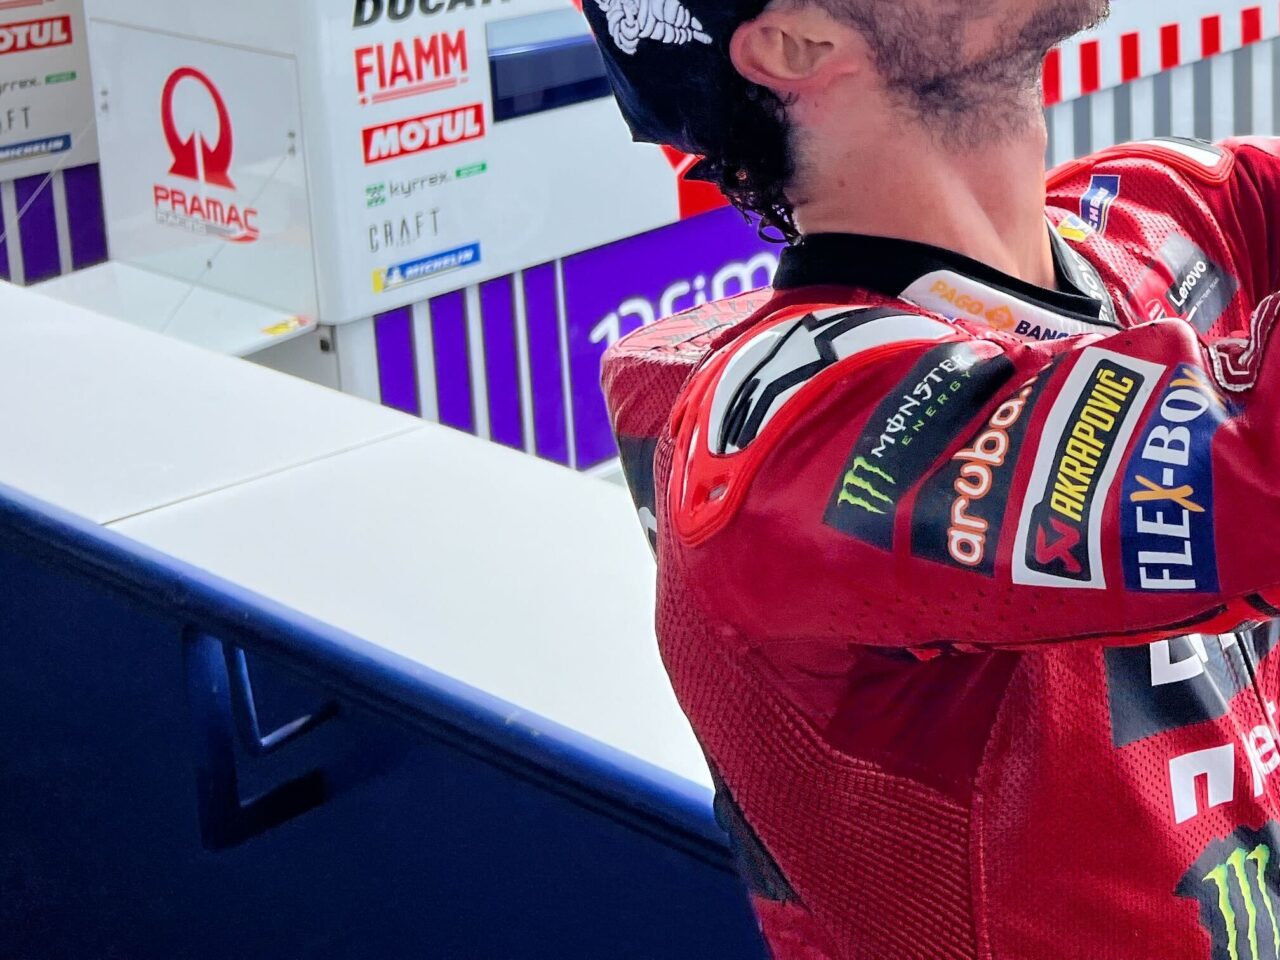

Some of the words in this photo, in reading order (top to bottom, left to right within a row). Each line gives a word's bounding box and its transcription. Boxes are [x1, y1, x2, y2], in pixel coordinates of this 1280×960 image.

[0, 19, 68, 52] OTUL
[354, 28, 468, 93] FIAMM
[368, 108, 481, 158] MOTUL
[153, 185, 259, 233] PRAMAC
[369, 208, 439, 252] CRAFT
[929, 280, 984, 315] PAGO
[1170, 261, 1207, 307] Lenovo
[871, 352, 972, 458] MONSTER
[902, 370, 971, 446] ENERGY
[1050, 368, 1134, 522] AKRAPOVIČ
